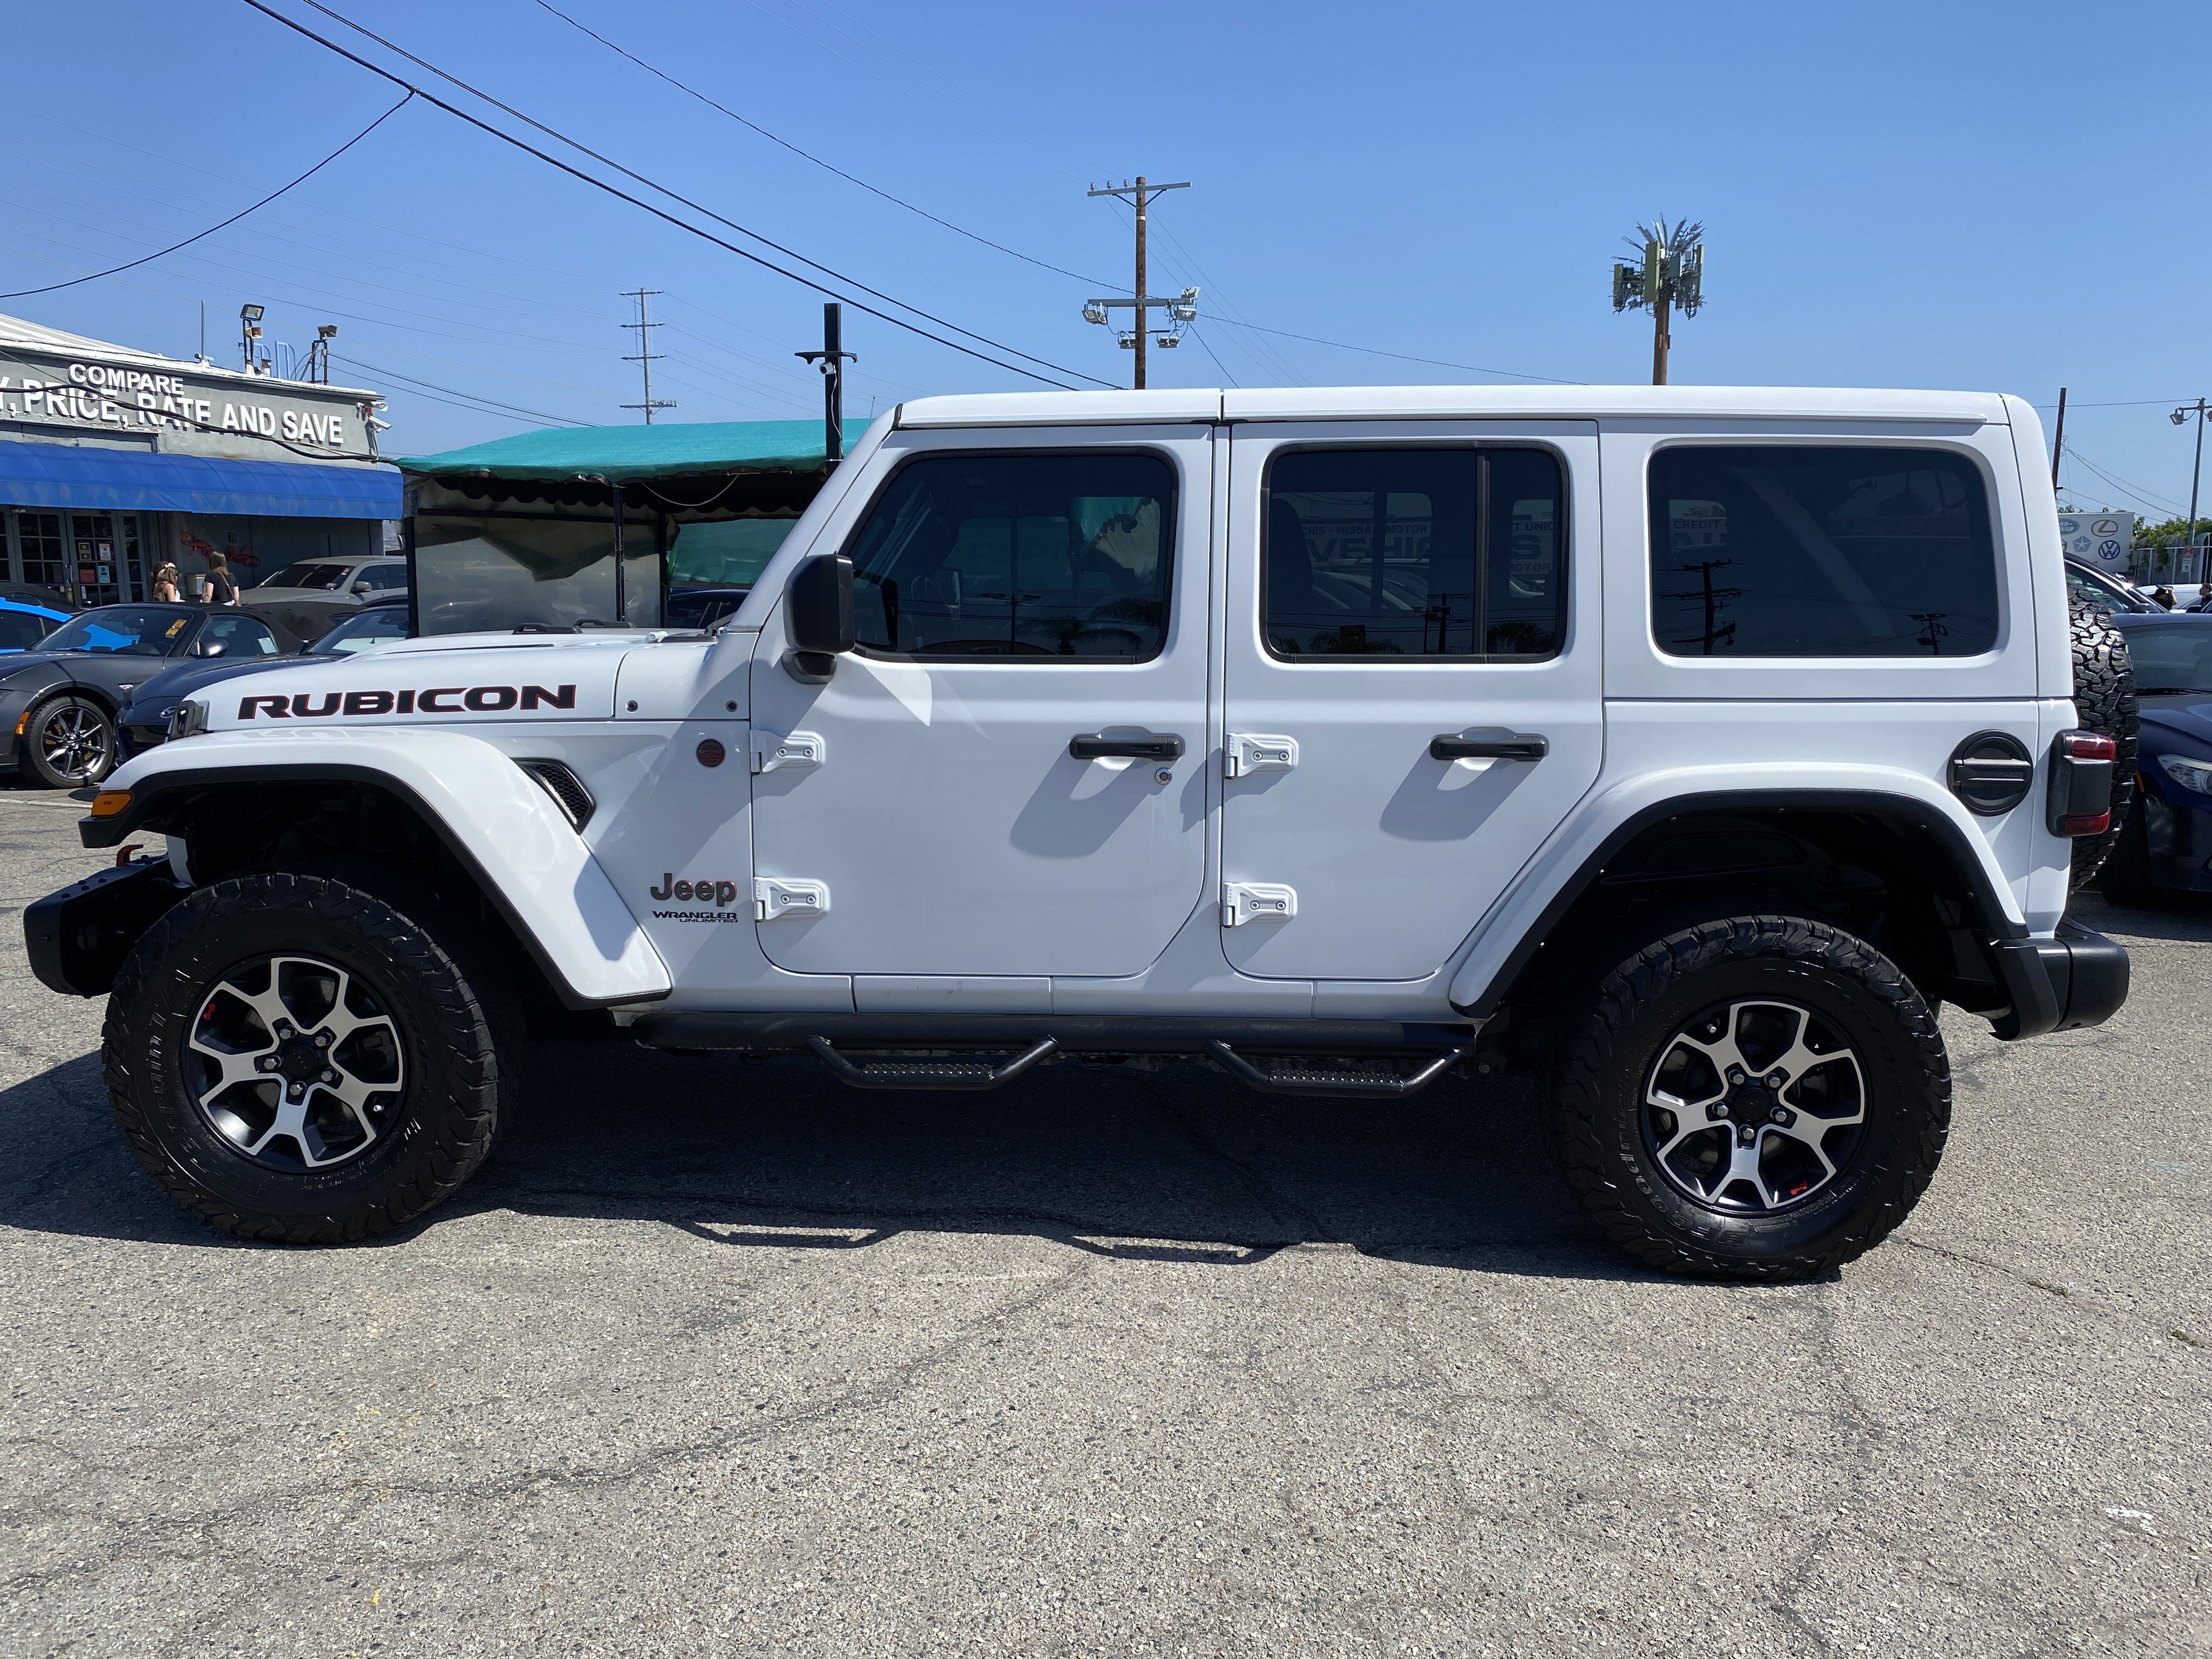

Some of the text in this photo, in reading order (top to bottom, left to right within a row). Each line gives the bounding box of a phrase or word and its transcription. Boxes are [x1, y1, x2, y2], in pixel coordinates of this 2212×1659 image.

[69, 363, 185, 396] COMPARE
[22, 379, 128, 428] PRICE,
[137, 392, 211, 432] RATE
[222, 403, 276, 436] AND
[282, 410, 344, 443] SAVE
[1302, 524, 1427, 535] CIES NISSA MOTOR
[1673, 520, 1721, 529] CREDIT
[238, 684, 577, 720] RUBICON
[650, 873, 737, 907] Jeep
[652, 911, 738, 919] WRANGLER
